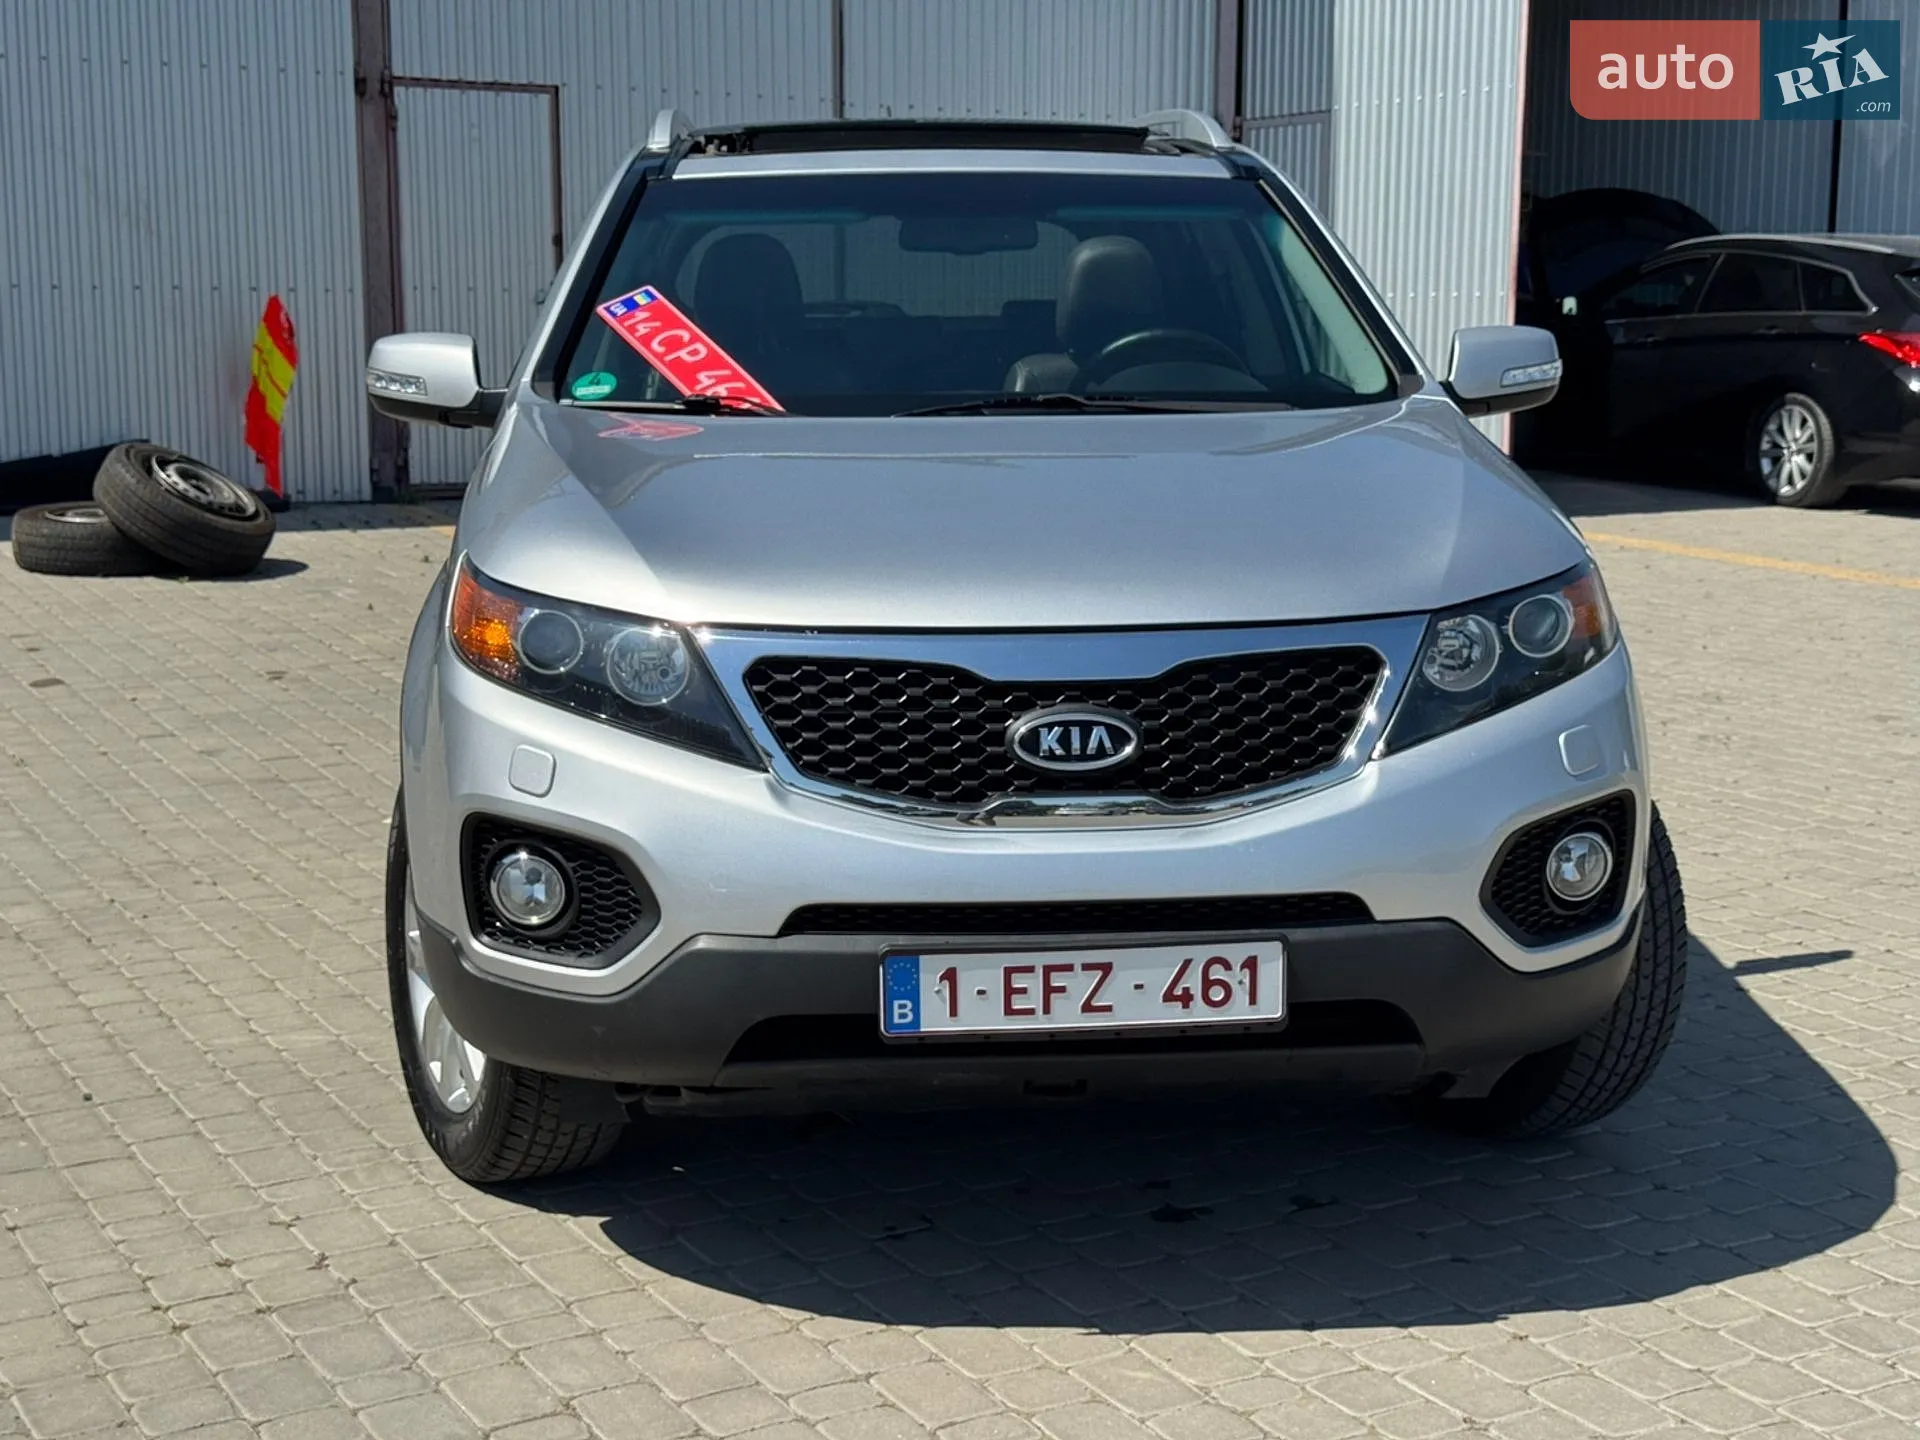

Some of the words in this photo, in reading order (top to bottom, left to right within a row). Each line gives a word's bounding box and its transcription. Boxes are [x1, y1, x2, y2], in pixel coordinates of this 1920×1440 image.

[623, 311, 662, 337] 14
[650, 328, 708, 362] CP
[1038, 725, 1116, 757] KIA
[892, 999, 914, 1025] B
